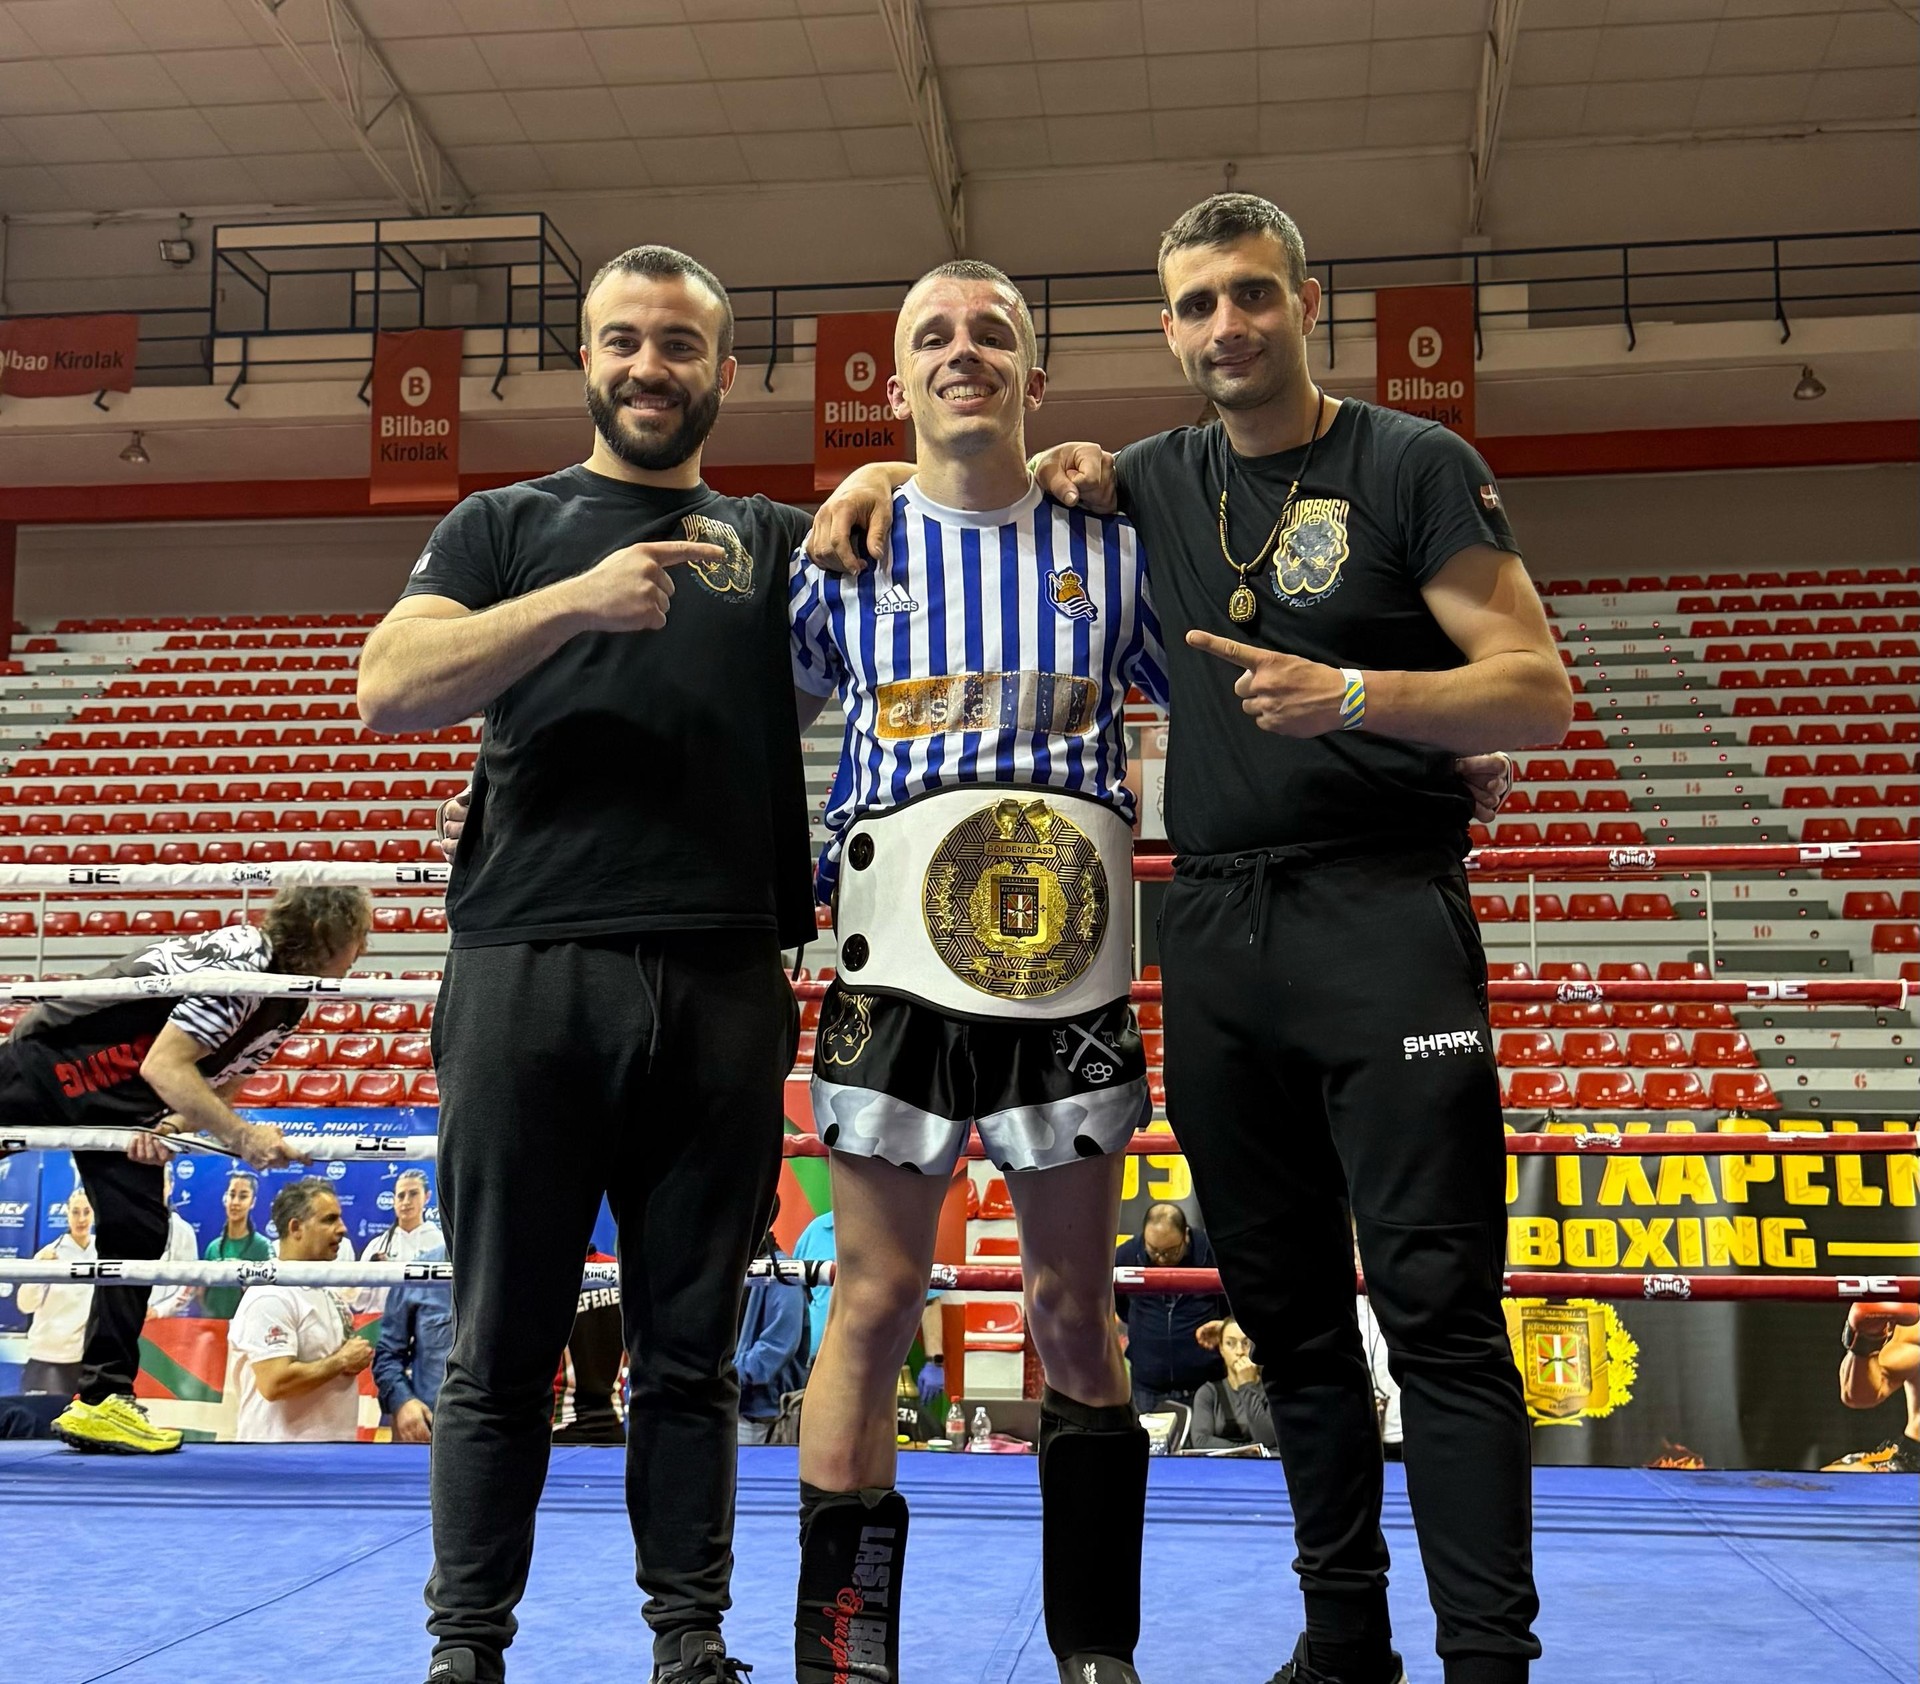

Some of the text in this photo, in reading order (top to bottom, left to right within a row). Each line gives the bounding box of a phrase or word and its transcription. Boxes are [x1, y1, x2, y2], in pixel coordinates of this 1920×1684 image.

[53, 350, 124, 370] Kirolak
[1387, 378, 1464, 401] Bilbao
[380, 415, 450, 438] Bilbao
[824, 427, 895, 449] Kirolak
[380, 441, 449, 463] Kirolak
[874, 600, 919, 615] adidas
[1686, 782, 1701, 795] 14
[987, 845, 1054, 855] GOLDEN CLASS
[1619, 853, 1646, 866] KING
[240, 870, 263, 881] KING
[1733, 885, 1750, 898] 11
[1753, 925, 1772, 938] 10
[985, 967, 1055, 981] TXAPELDUN
[1567, 988, 1594, 1001] KING
[1403, 1030, 1482, 1053] SHARK
[1830, 1032, 1841, 1049] 7
[1405, 1046, 1484, 1061] BOXING
[1854, 1072, 1867, 1089] 6
[322, 1122, 369, 1132] MUAY
[1507, 1217, 1817, 1268] BOXING
[246, 1267, 269, 1280] KING
[584, 1270, 608, 1280] KING
[1653, 1280, 1681, 1293] KING
[852, 1526, 896, 1608] LAST
